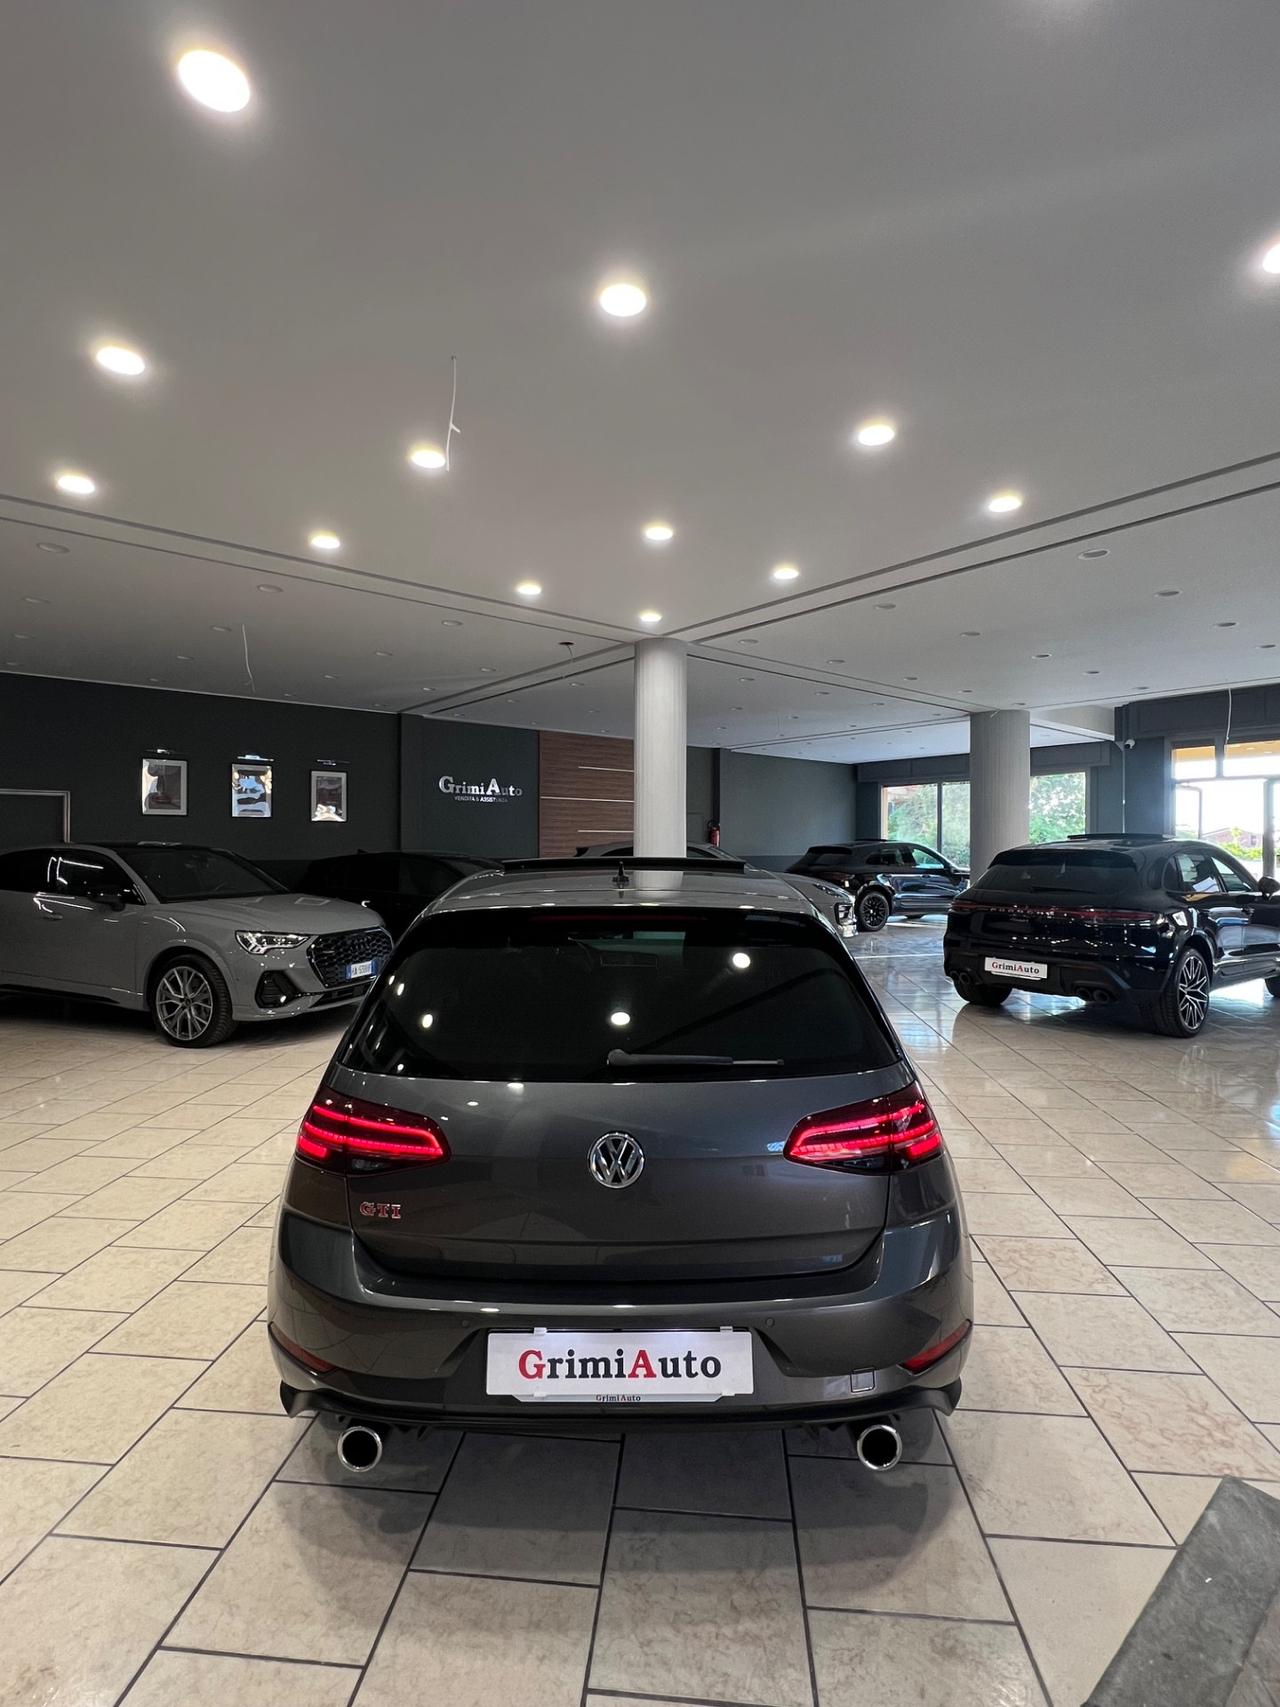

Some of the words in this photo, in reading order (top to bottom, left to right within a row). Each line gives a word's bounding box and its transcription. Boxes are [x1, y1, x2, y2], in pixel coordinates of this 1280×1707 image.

[992, 961, 1040, 974] GrimiAuto
[360, 1202, 401, 1219] GTI
[518, 1349, 722, 1379] GrimiAuto
[596, 1394, 641, 1402] GrimiAuto
